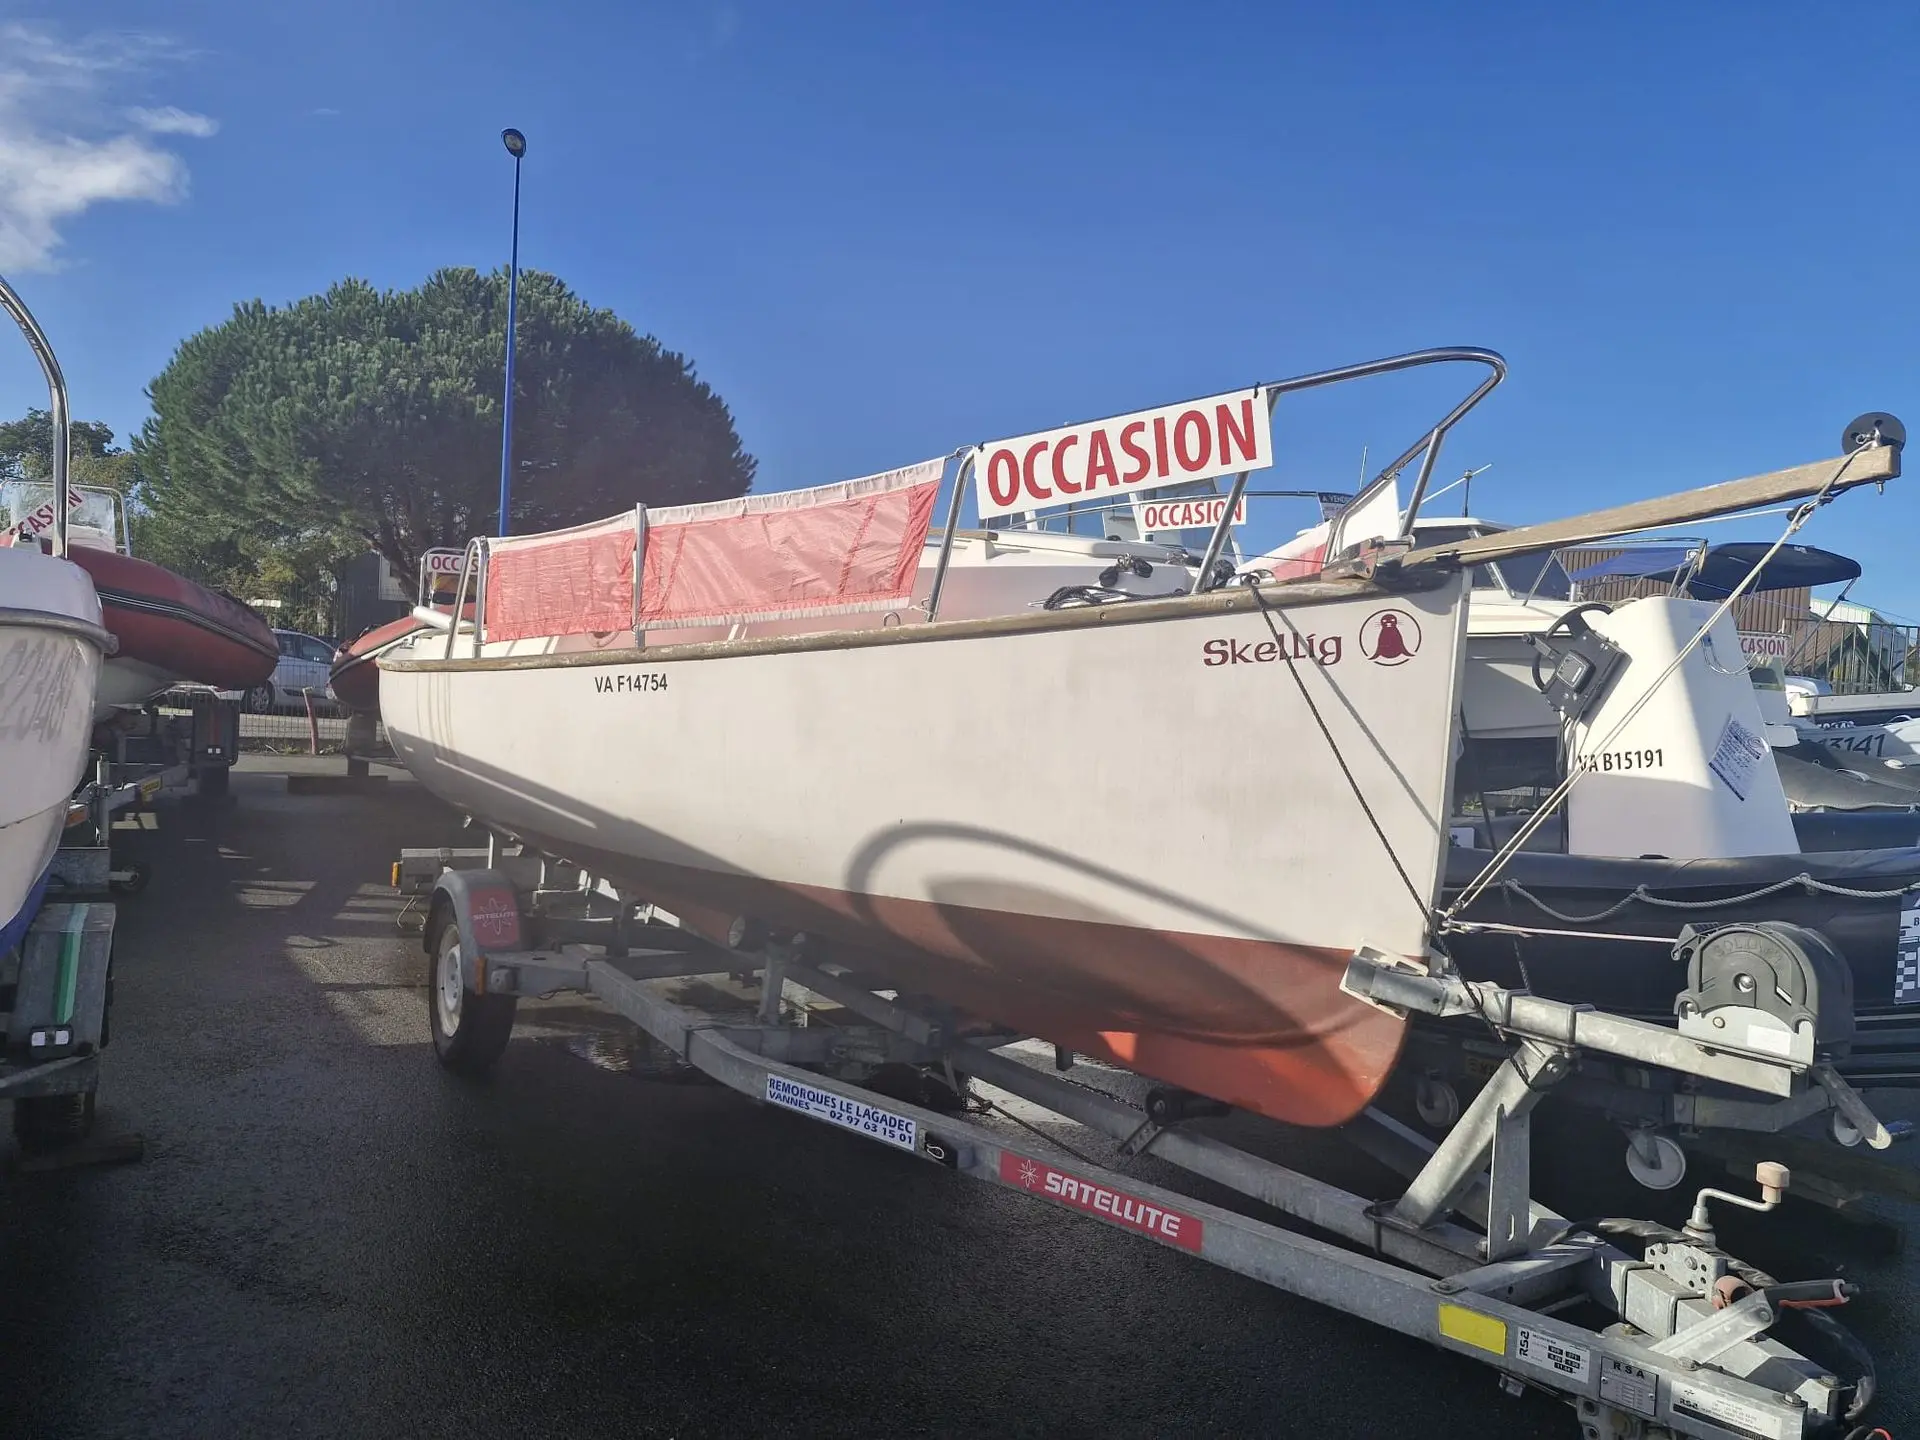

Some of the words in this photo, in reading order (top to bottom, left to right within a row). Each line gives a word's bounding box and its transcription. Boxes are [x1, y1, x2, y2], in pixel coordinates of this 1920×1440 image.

[987, 399, 1257, 506] OCCASION
[1203, 632, 1342, 666] Skellig
[1740, 638, 1785, 655] CASION
[594, 675, 614, 693] VA
[617, 673, 668, 693] F14754
[1577, 754, 1598, 772] VA
[1603, 748, 1663, 771] B15191
[769, 1078, 837, 1109] REMORQUES
[840, 1100, 853, 1114] LE
[856, 1106, 913, 1134] LAGADEC
[769, 1090, 810, 1111] VANNES
[829, 1110, 842, 1121] 02
[846, 1116, 860, 1127] 97
[864, 1121, 878, 1133] 63
[882, 1127, 895, 1139] 15
[899, 1133, 913, 1145] 01
[1045, 1172, 1181, 1237] SATELLITE
